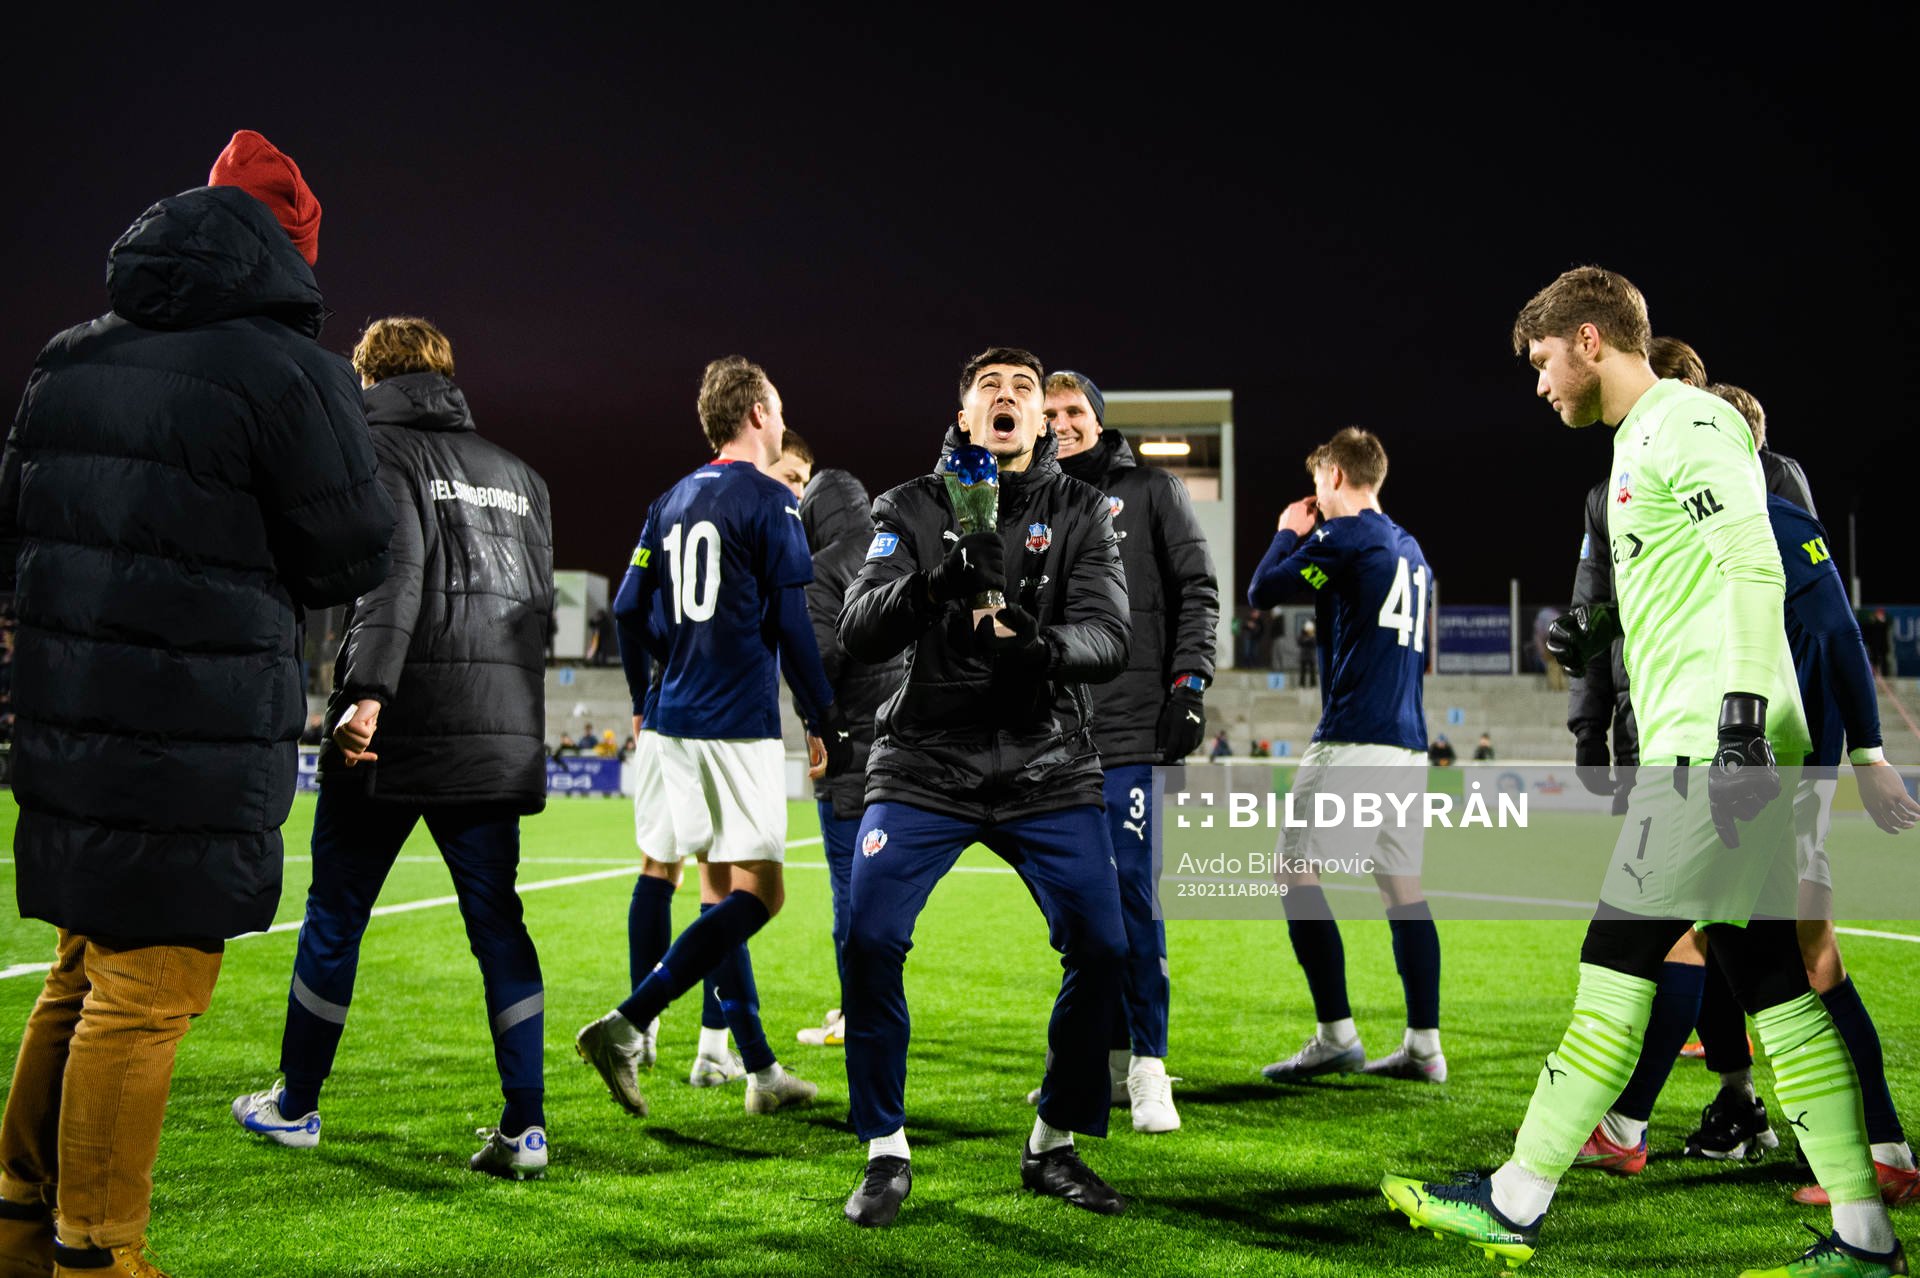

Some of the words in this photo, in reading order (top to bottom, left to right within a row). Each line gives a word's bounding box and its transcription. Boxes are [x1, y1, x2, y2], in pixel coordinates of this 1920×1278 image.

[517, 495, 529, 517] IF
[1681, 488, 1724, 526] XXL
[663, 520, 721, 624] 10
[1378, 556, 1426, 653] 41
[1129, 787, 1145, 819] 3
[1637, 816, 1652, 860] 1
